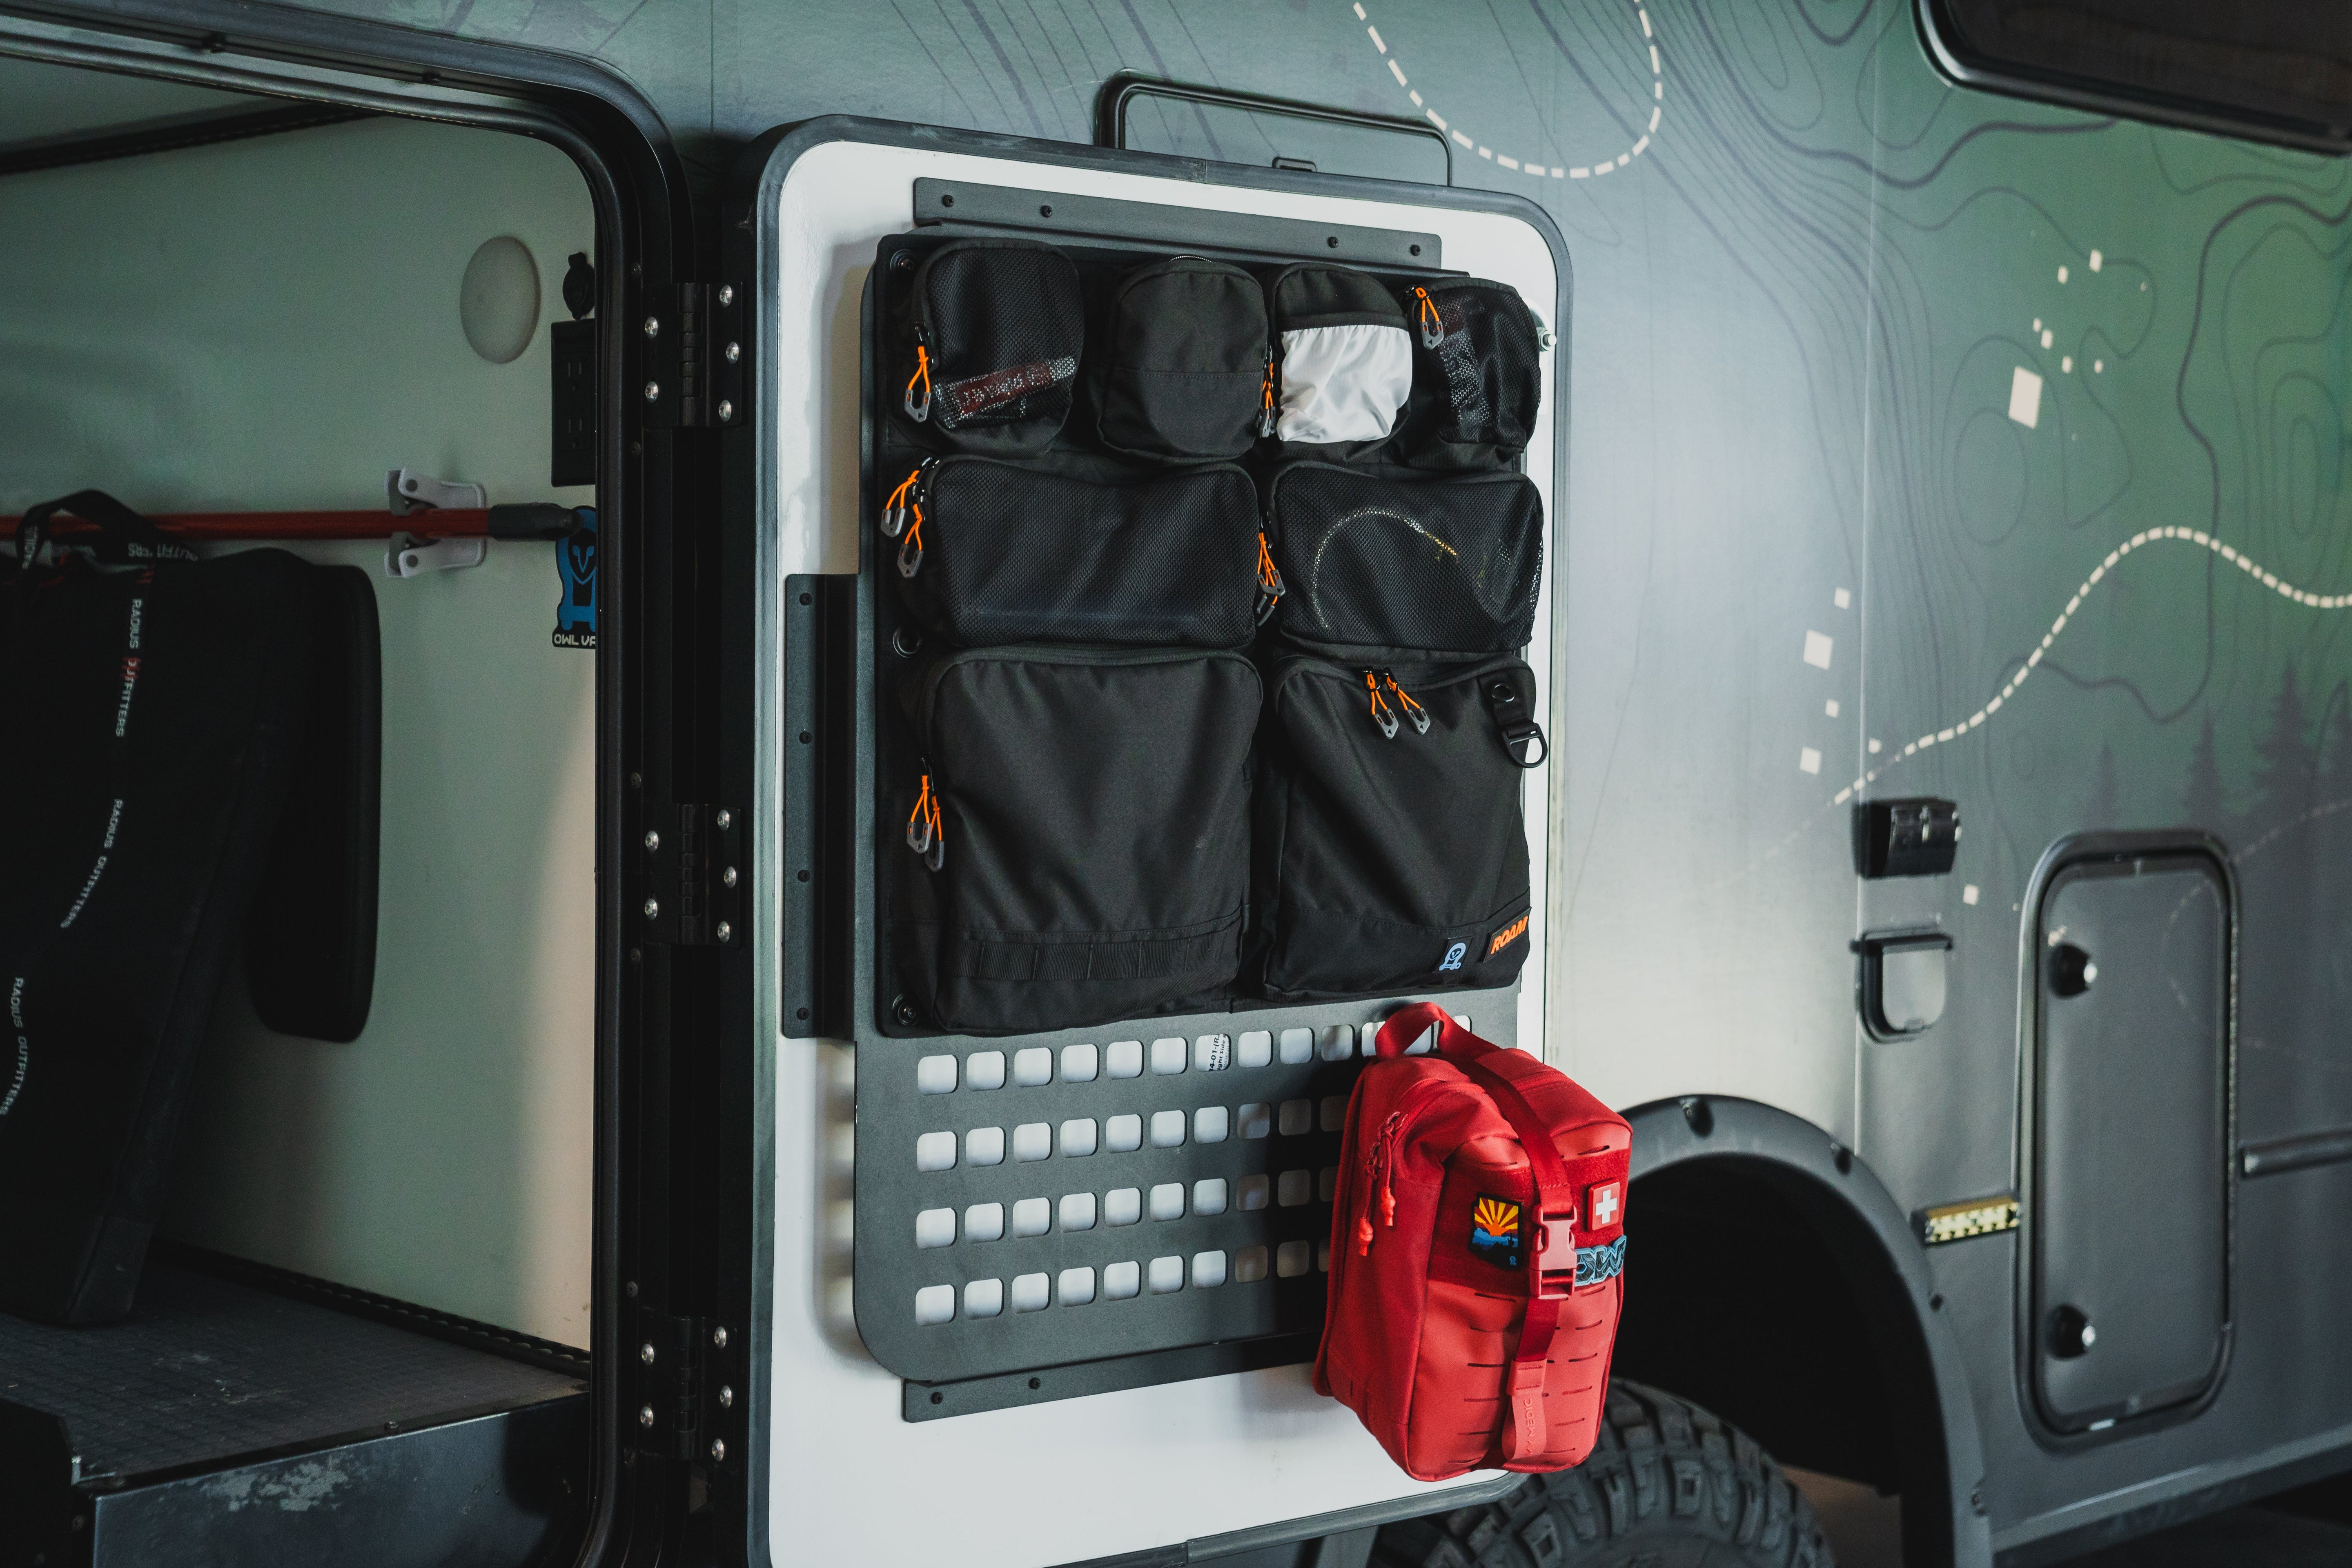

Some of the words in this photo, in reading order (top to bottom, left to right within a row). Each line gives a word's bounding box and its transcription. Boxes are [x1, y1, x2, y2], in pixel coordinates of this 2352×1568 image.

[129, 598, 143, 649] RADIUS
[554, 634, 579, 645] OWL
[104, 798, 124, 849] RADIUS
[60, 855, 108, 928] OUTFITTERS
[1490, 915, 1528, 955] ROAM
[10, 977, 25, 1029] RADIUS
[0, 1035, 29, 1116] OUTFITTERS
[1523, 1398, 1536, 1437] MEDIC
